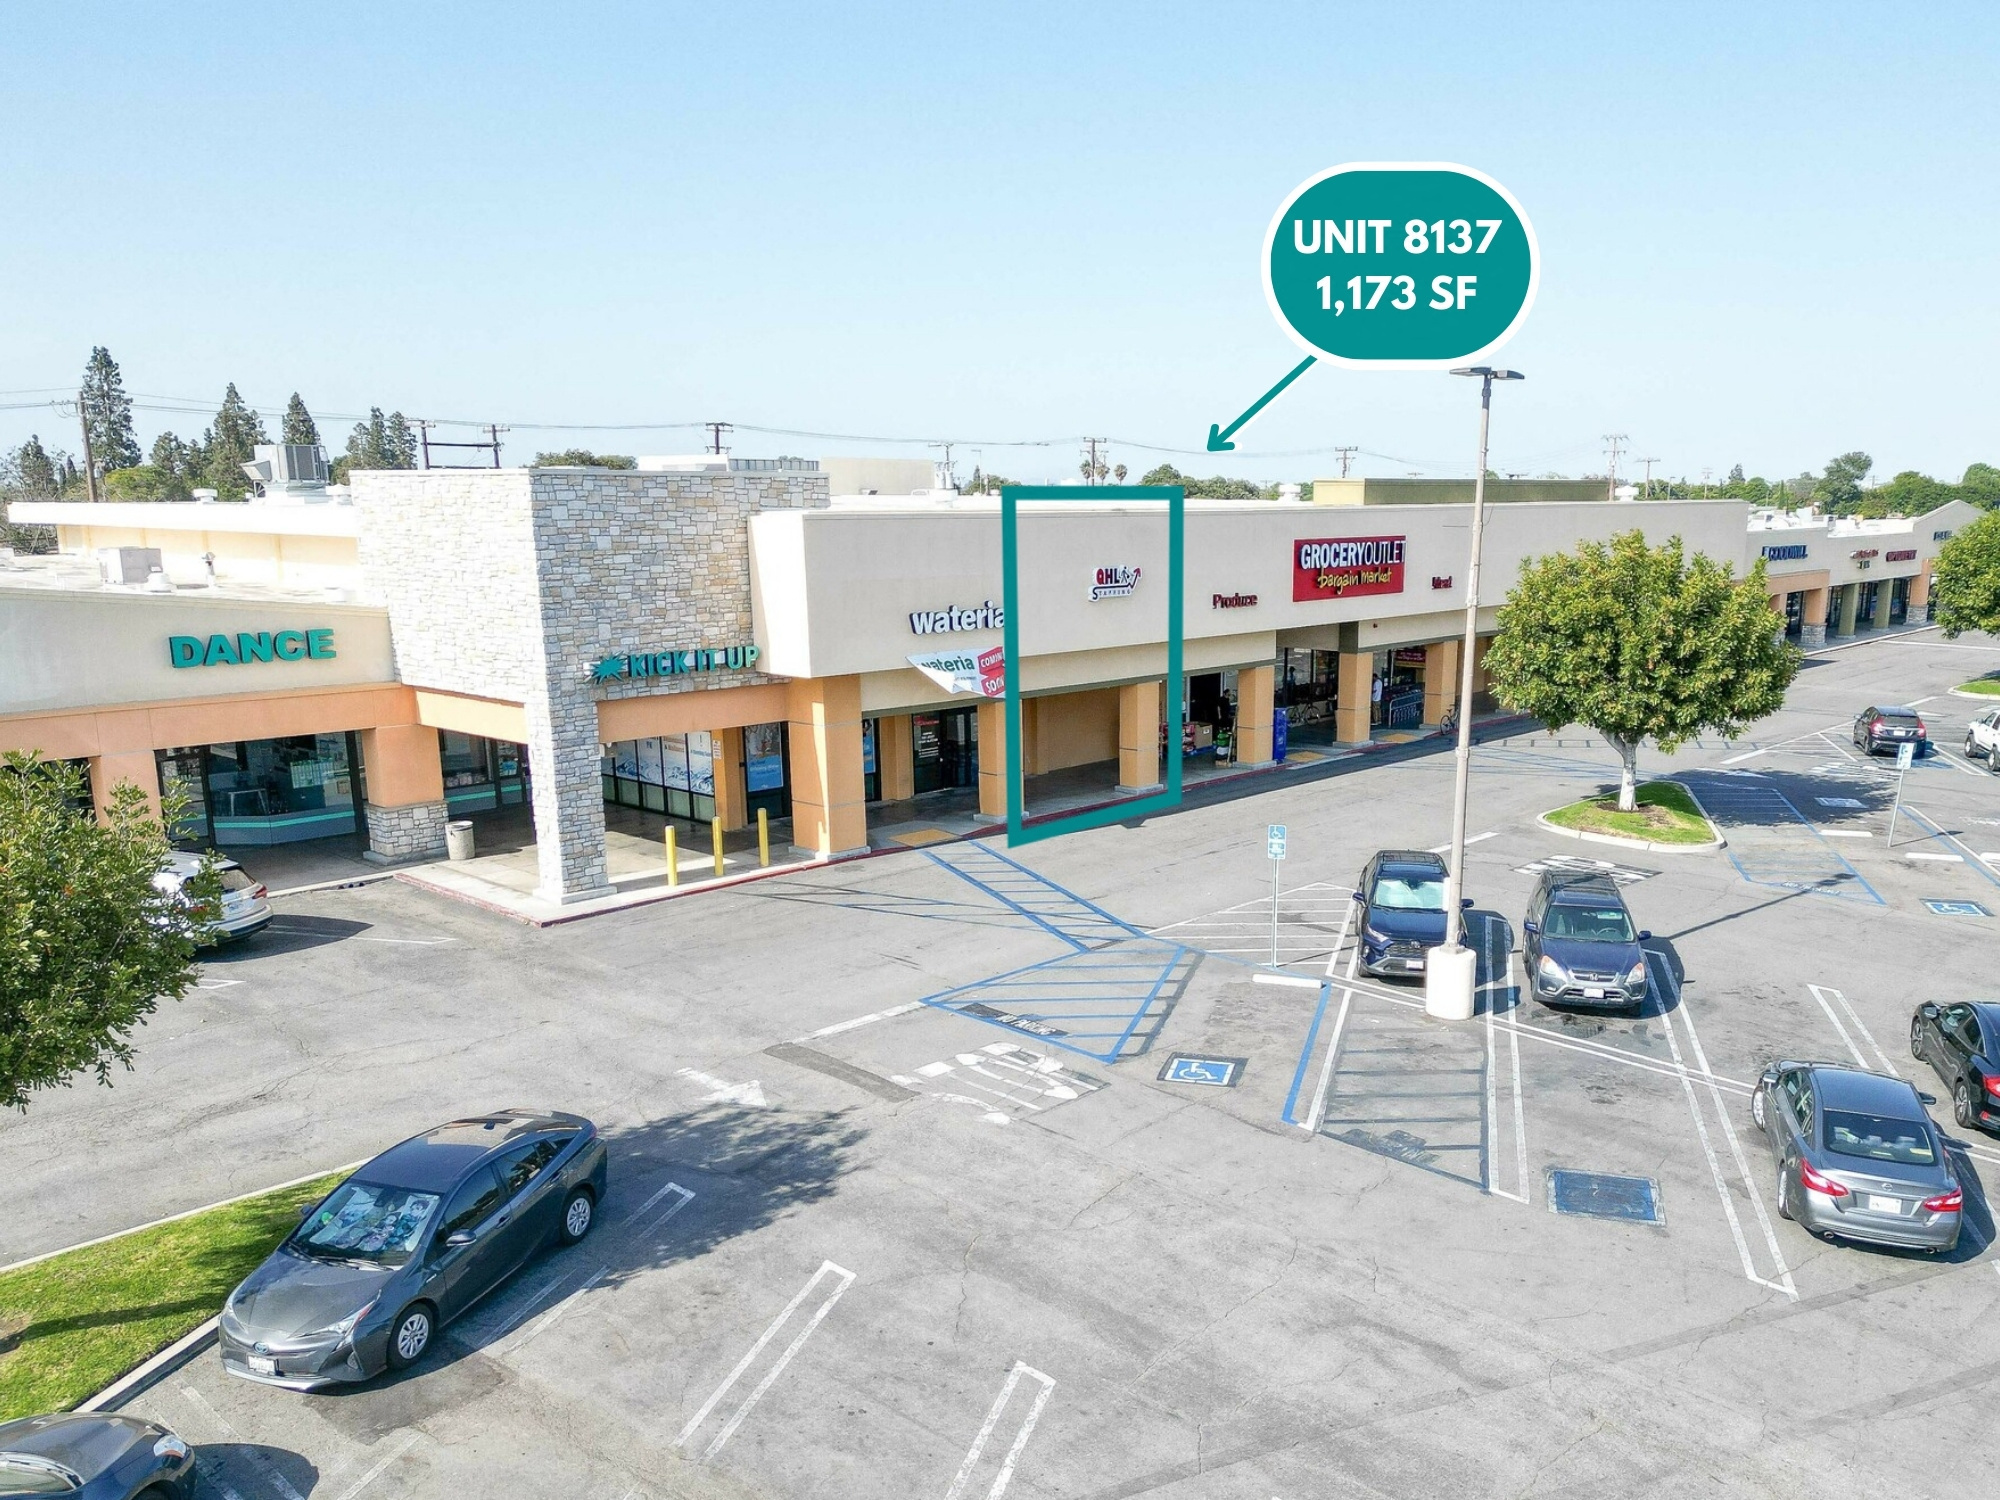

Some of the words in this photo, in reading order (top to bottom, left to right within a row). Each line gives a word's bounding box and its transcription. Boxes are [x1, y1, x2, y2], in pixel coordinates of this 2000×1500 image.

[1212, 593, 1258, 609] Produce
[169, 629, 337, 668] DANCE
[628, 651, 690, 679] KICK
[694, 648, 718, 673] IT
[725, 645, 761, 670] UP
